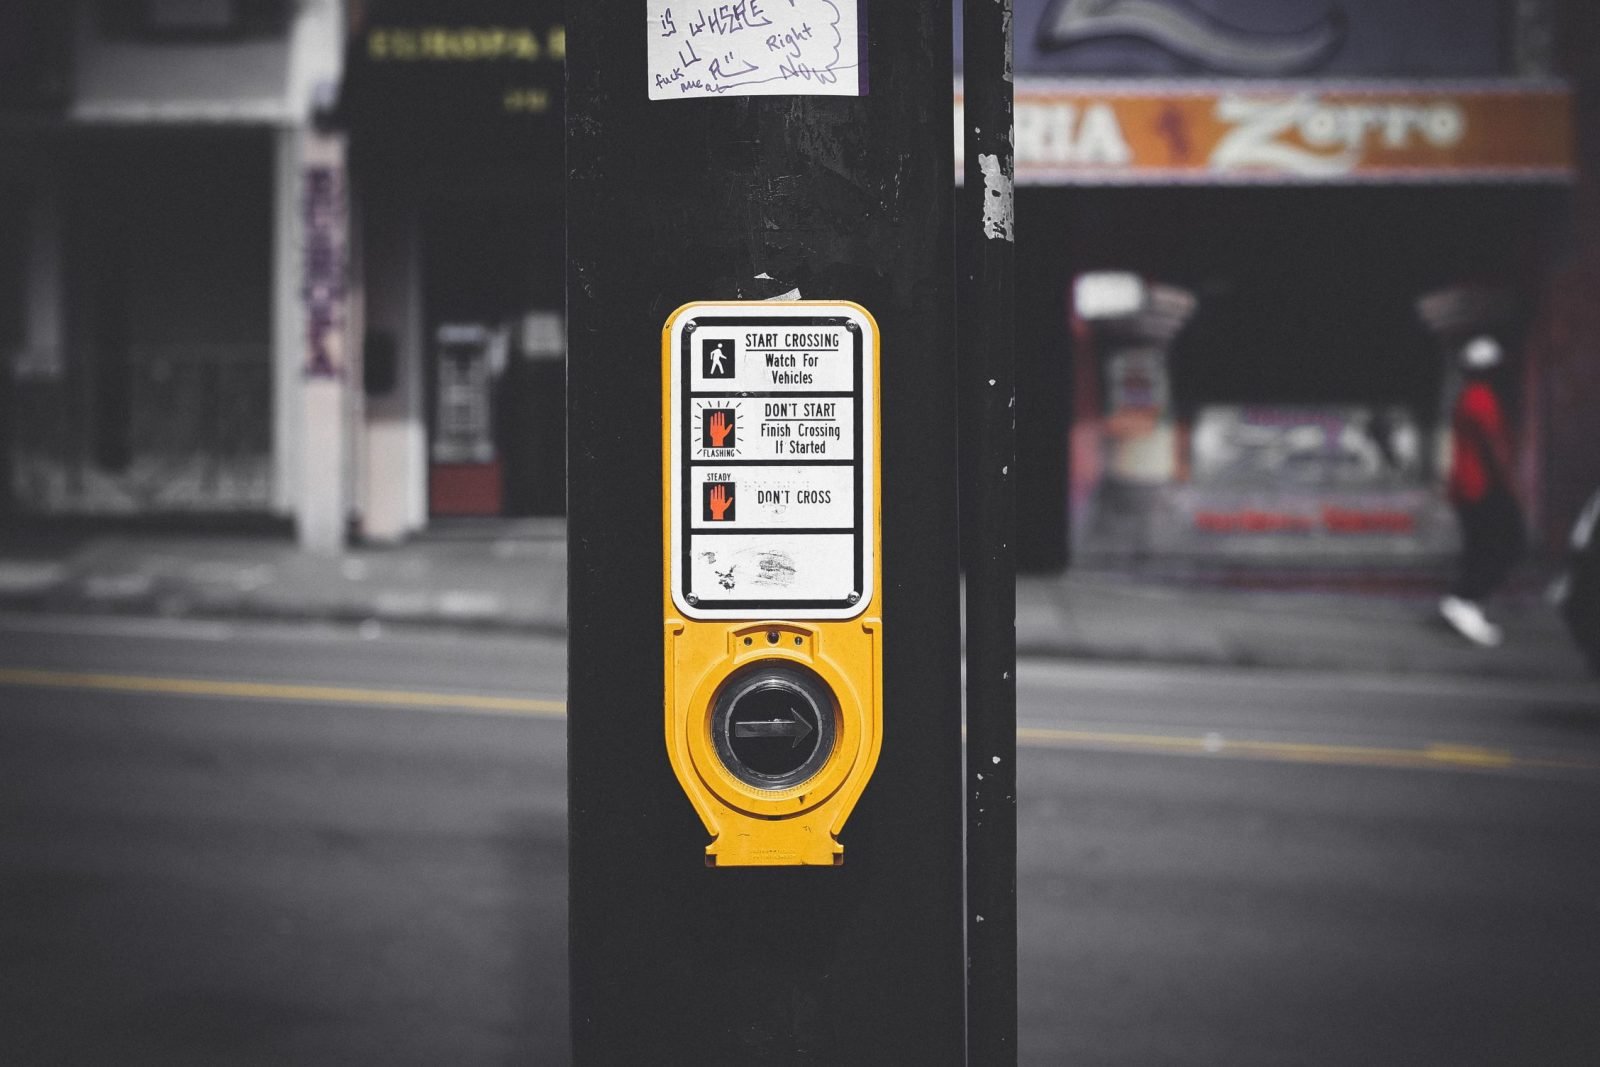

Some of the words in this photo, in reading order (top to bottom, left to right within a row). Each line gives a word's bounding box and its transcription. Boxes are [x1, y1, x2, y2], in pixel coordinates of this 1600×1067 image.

[766, 22, 812, 58] Right
[655, 67, 685, 89] fuck
[745, 333, 778, 347] START
[785, 333, 839, 347] CROSSING
[765, 354, 796, 367] Watch
[803, 354, 819, 367] For
[771, 371, 813, 384] Vehicles
[765, 403, 797, 417] DON'T
[804, 403, 836, 417] START
[761, 424, 791, 437] Finish
[798, 424, 840, 440] Crossing
[703, 449, 735, 457] FLASHING
[775, 440, 784, 454] If
[789, 440, 826, 454] Started
[707, 473, 731, 481] STEADY
[758, 490, 790, 504] DON'T
[797, 490, 831, 504] CROSS
